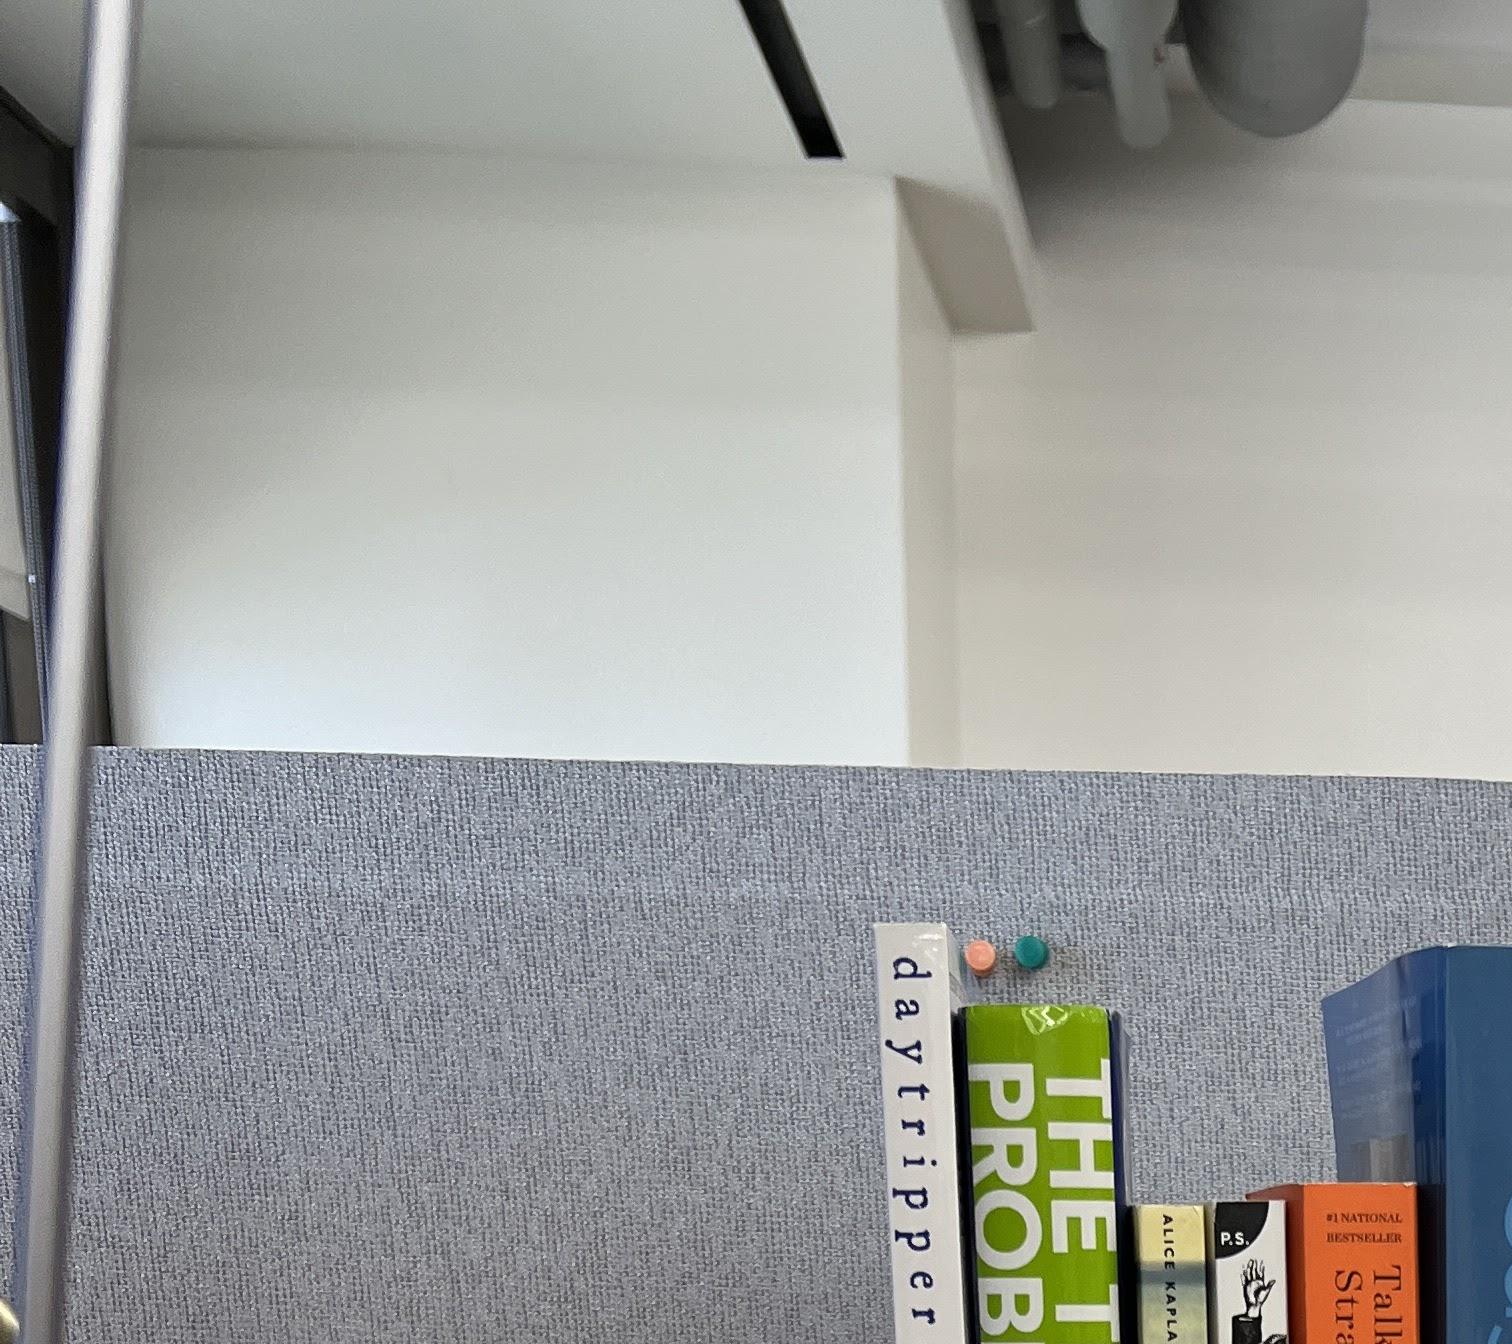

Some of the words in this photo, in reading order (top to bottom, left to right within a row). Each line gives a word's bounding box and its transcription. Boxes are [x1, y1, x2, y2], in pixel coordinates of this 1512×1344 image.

[885, 955, 939, 1327] daytripper
[1045, 1057, 1115, 1254] THE
[1326, 1213, 1339, 1224] #1
[1341, 1212, 1402, 1224] NATIONAL
[1162, 1213, 1175, 1271] ALICE
[1219, 1231, 1251, 1247] P.S.
[1326, 1232, 1403, 1244] BESTSELLER
